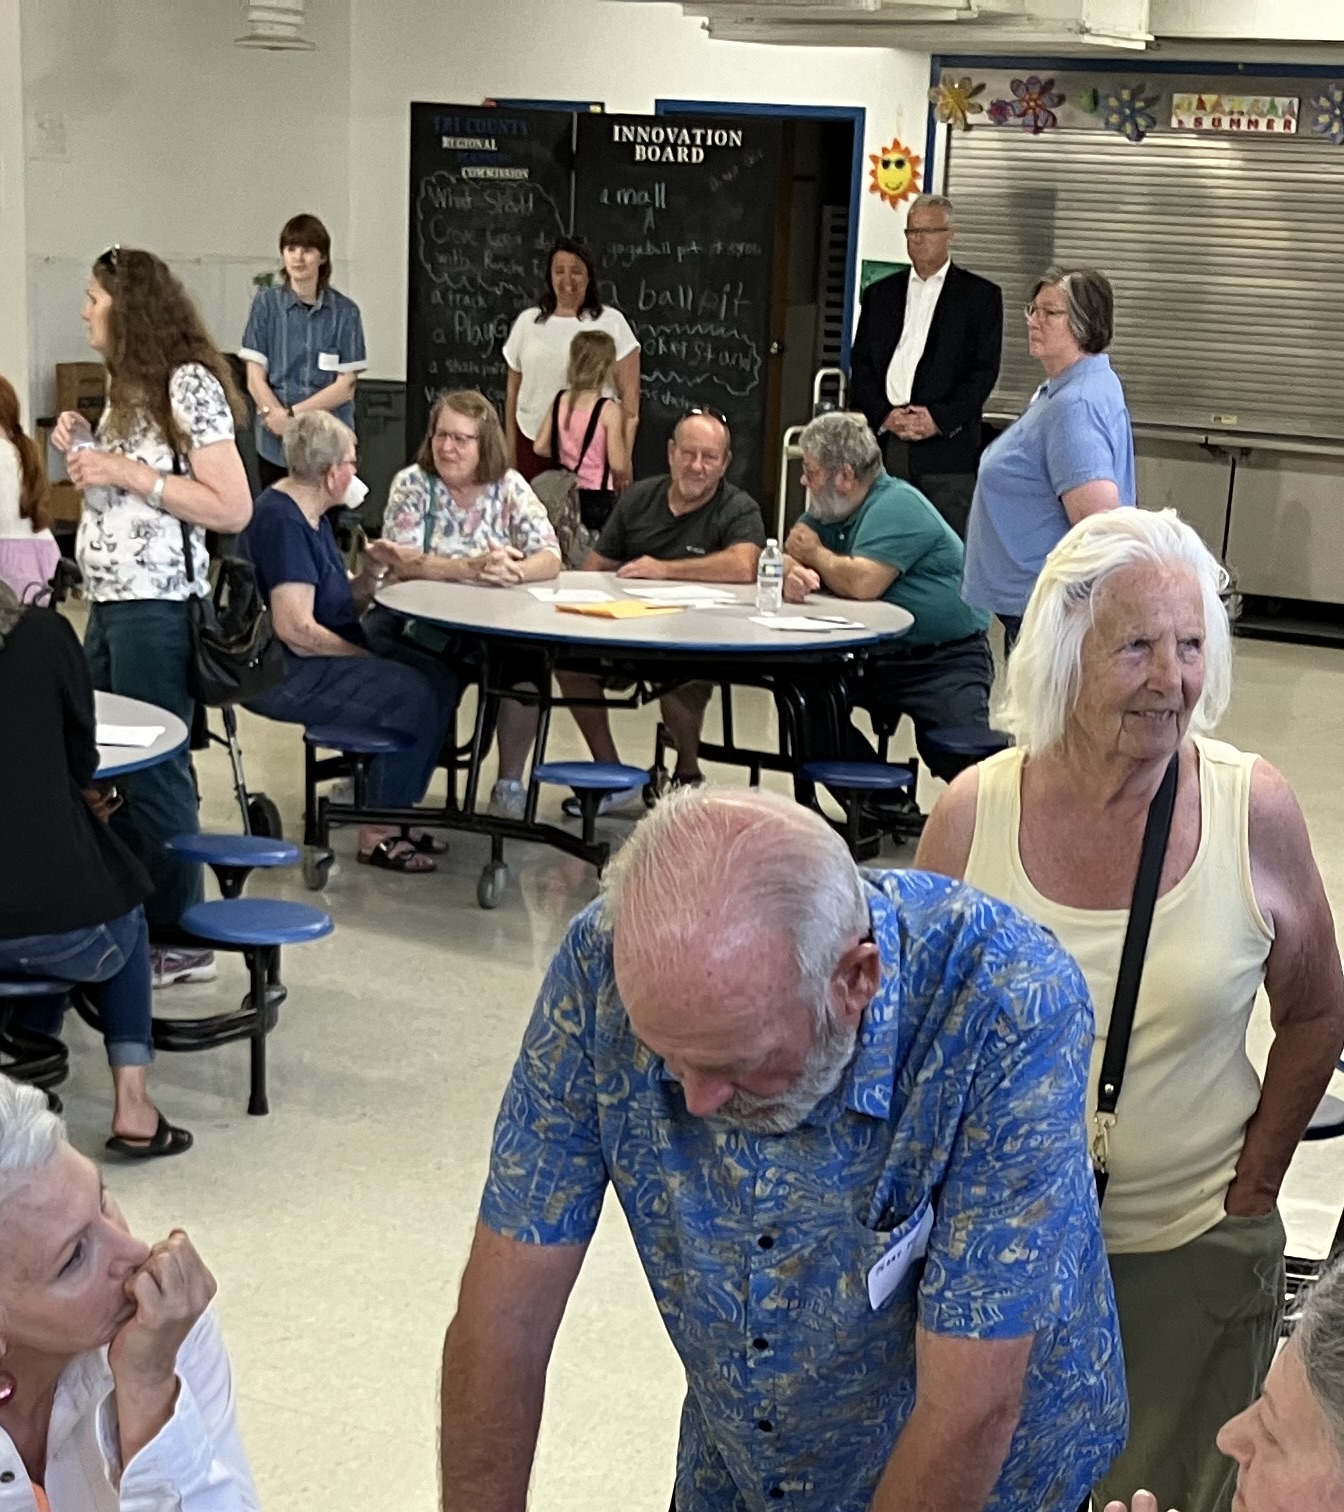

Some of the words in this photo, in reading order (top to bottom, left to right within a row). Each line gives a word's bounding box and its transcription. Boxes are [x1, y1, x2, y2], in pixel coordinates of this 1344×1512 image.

[441, 135, 498, 151] REGIONAL
[613, 124, 743, 147] INNOVATION
[634, 144, 704, 163] BOARD
[460, 166, 529, 180] COMMISSION
[638, 278, 694, 312] ball
[697, 281, 753, 321] pit
